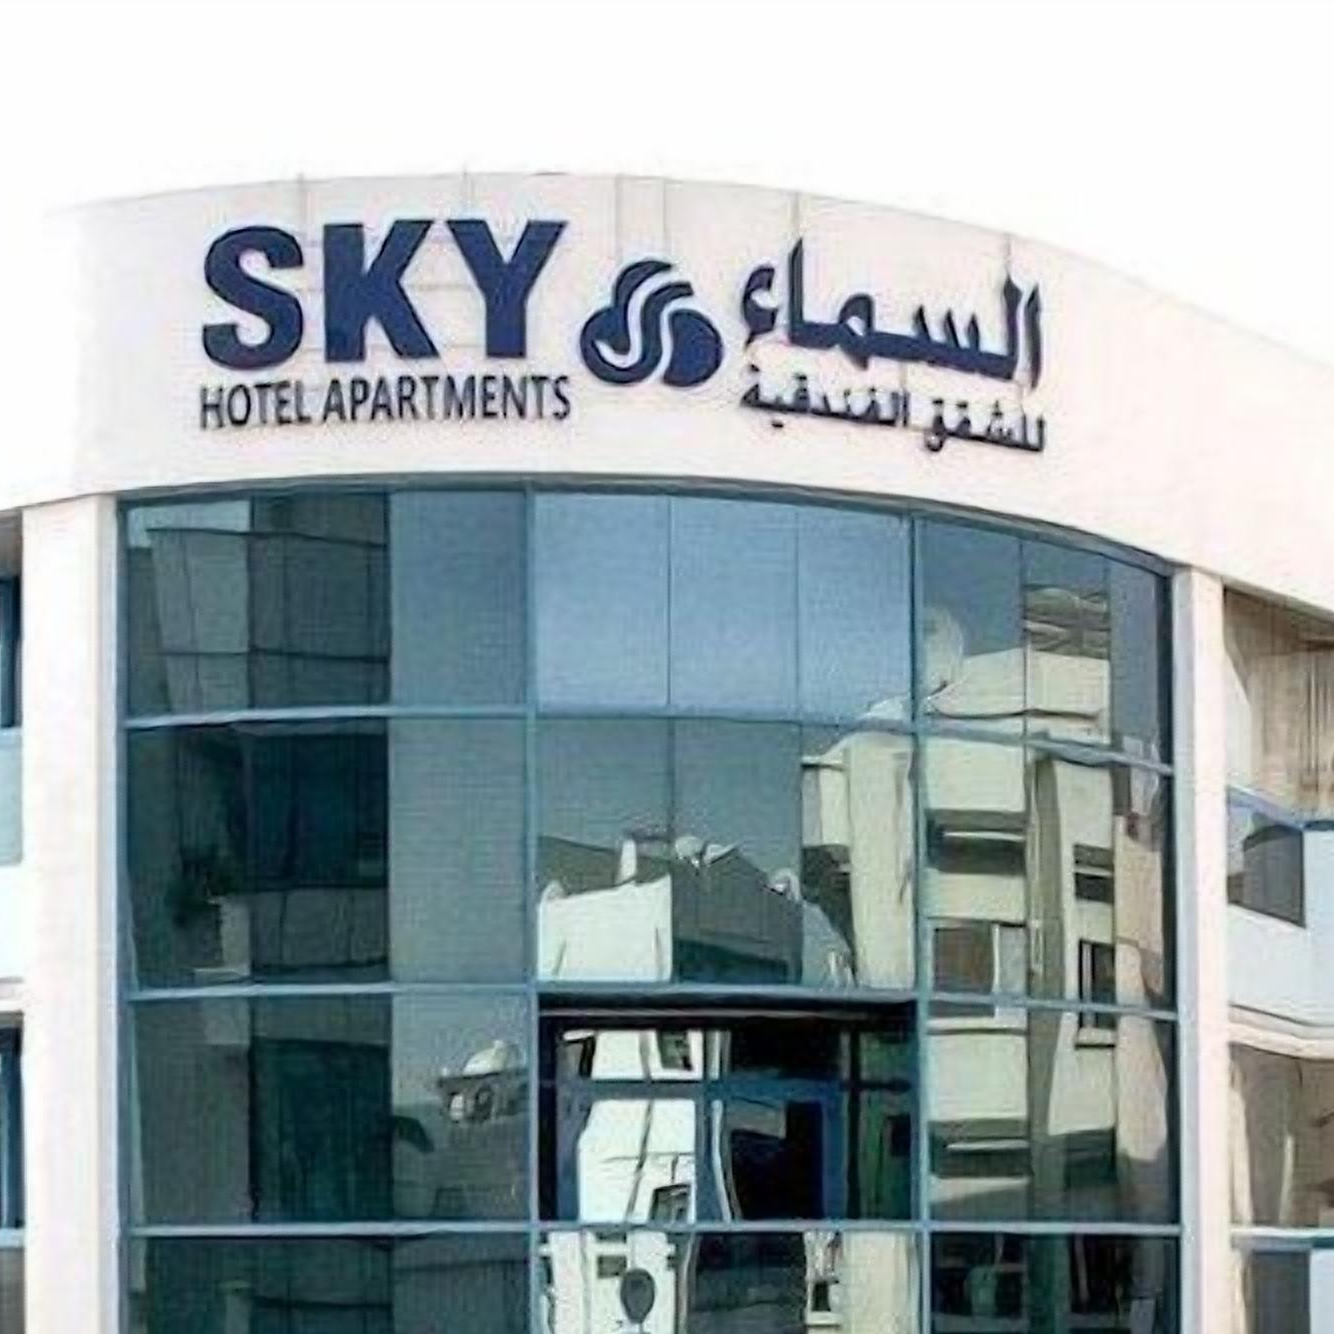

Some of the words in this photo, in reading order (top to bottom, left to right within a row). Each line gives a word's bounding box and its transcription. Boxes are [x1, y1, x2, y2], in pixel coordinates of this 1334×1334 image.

[202, 219, 568, 371] SKY
[742, 237, 1042, 390] السماء
[199, 380, 312, 430] HOTEL
[323, 375, 571, 422] APARTMENTS
[740, 363, 911, 428] الفندقية
[923, 398, 1045, 452] للشقق
